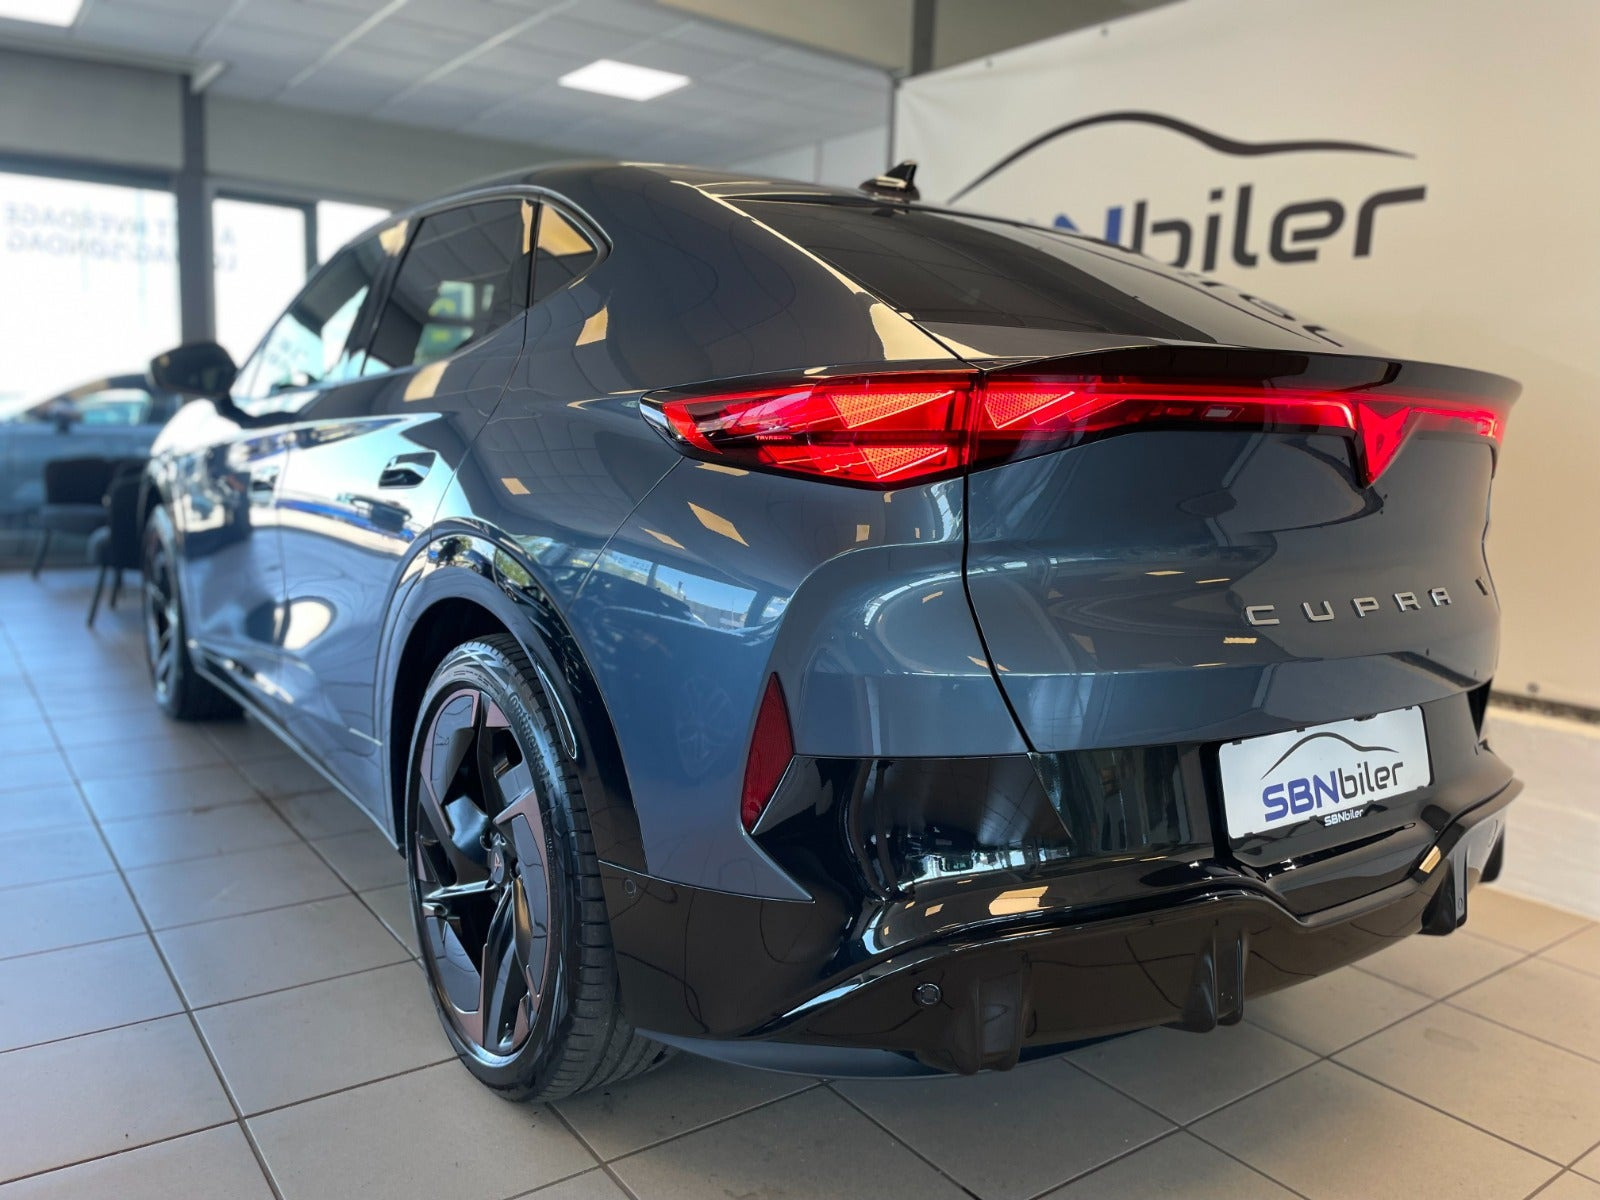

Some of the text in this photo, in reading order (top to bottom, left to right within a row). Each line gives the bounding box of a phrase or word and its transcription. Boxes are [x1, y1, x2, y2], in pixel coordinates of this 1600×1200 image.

[1053, 184, 1427, 272] biler
[1245, 587, 1452, 626] CUPRA
[1262, 761, 1404, 822] SBNbiler
[1323, 808, 1364, 827] SBNbiler
